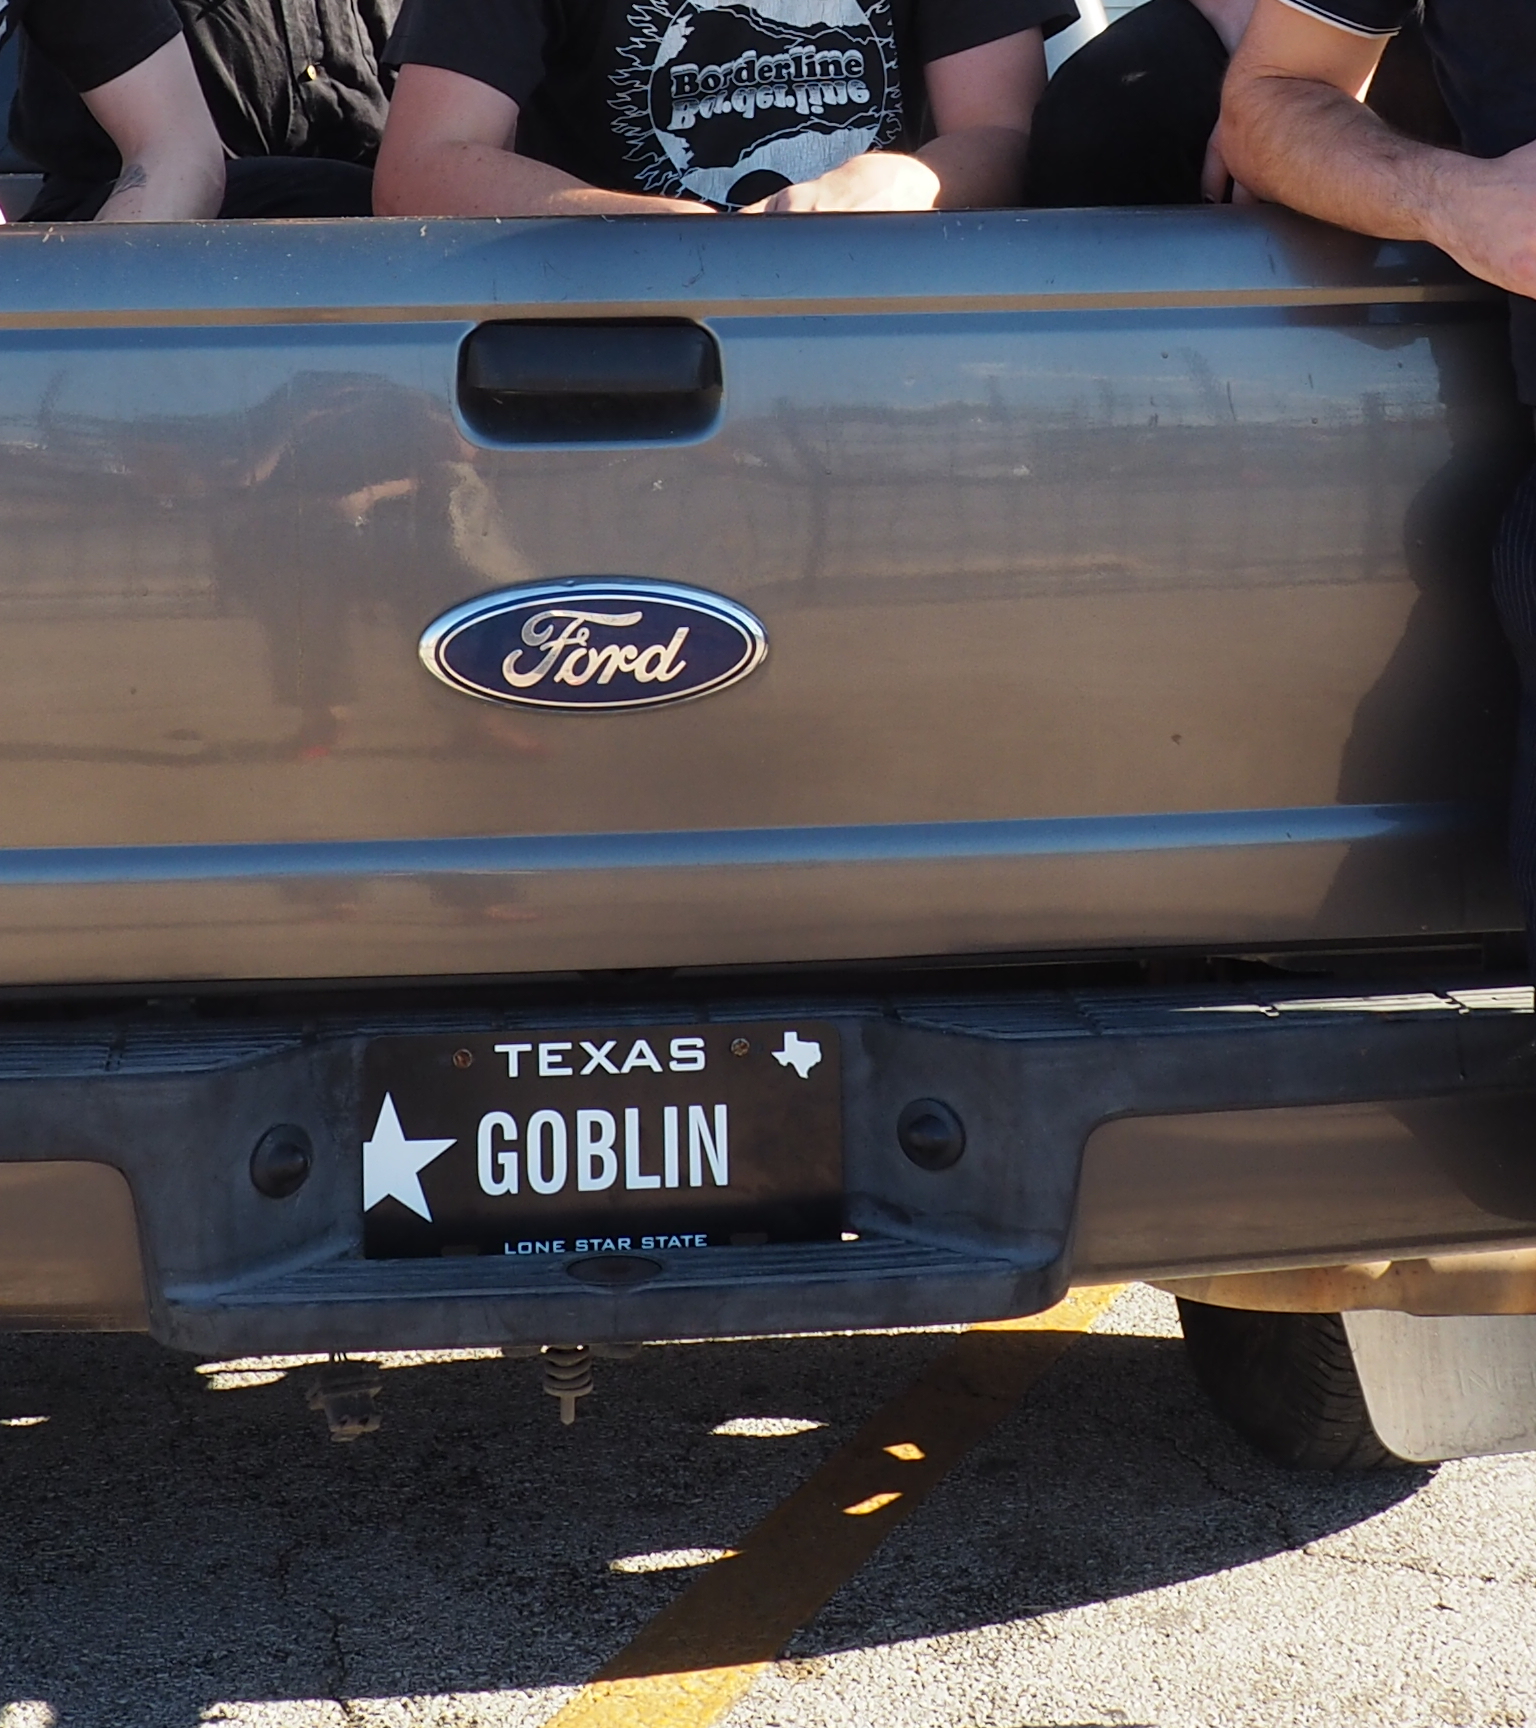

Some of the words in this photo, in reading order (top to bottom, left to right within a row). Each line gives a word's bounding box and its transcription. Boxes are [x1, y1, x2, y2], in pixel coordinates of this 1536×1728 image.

[669, 43, 866, 99] Borderline
[501, 609, 690, 688] Ford
[493, 1036, 707, 1079] TEXAS
[475, 1103, 730, 1197] GOBLIN
[503, 1238, 567, 1256] LONE
[574, 1236, 632, 1253] STAR
[640, 1233, 708, 1251] STATE
